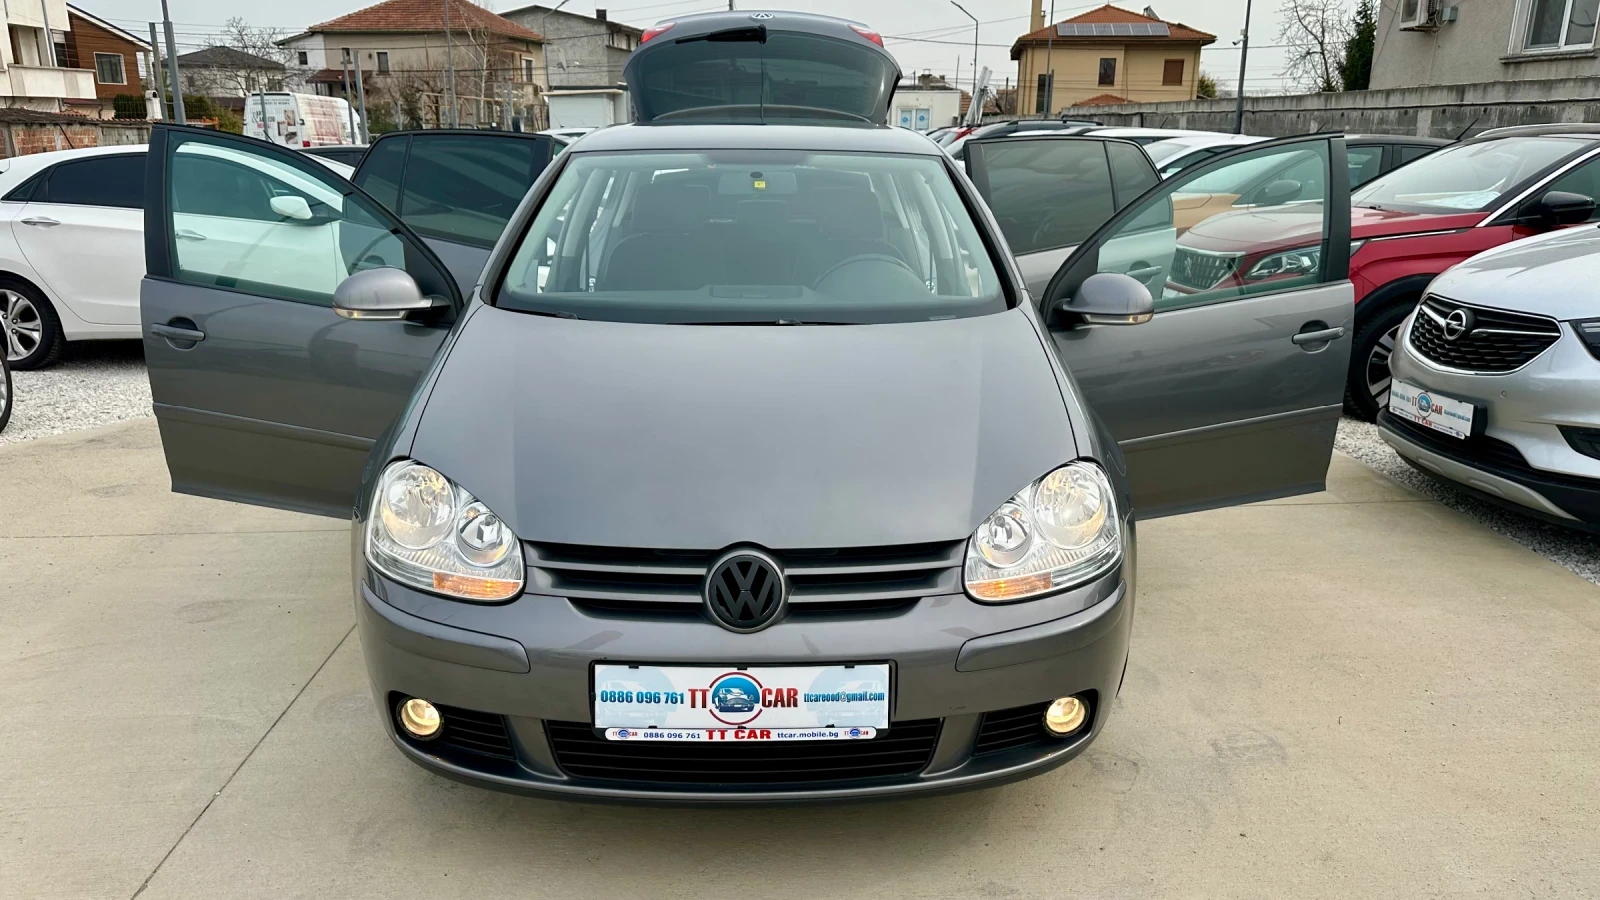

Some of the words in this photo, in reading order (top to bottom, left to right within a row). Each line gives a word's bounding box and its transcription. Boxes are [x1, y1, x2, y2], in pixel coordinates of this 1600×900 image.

[1431, 403, 1442, 415] CAR
[600, 690, 633, 703] 0886
[636, 691, 661, 704] 096
[664, 692, 685, 704] 761
[688, 688, 710, 709] TT
[761, 687, 798, 708] CAR
[803, 691, 885, 703] ttcareood@gmail.com
[706, 729, 728, 740] TT
[734, 729, 772, 740] CAR
[777, 731, 839, 739] ttcar.mobile.bg
